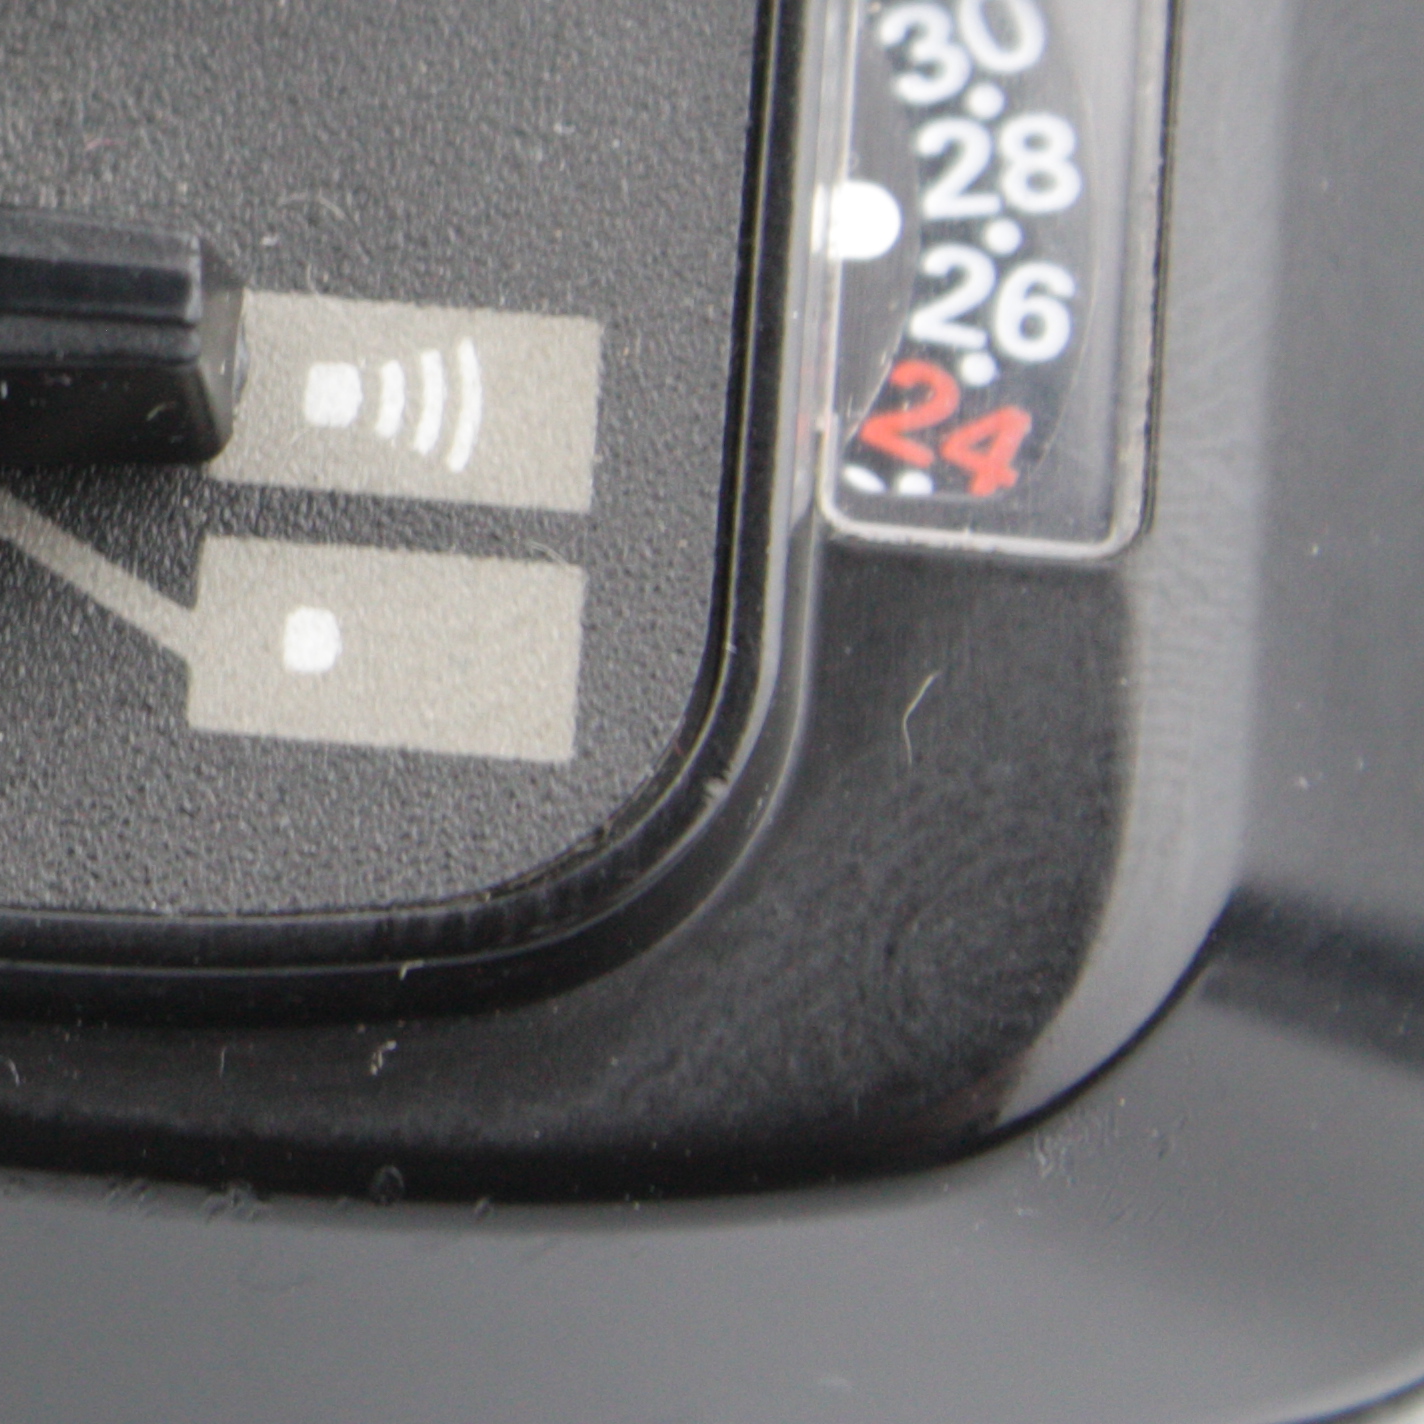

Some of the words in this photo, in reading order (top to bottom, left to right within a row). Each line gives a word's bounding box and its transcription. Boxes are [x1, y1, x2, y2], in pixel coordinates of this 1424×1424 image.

[915, 112, 1082, 221] 28
[909, 243, 1076, 362] 26
[860, 358, 1032, 497] 24
